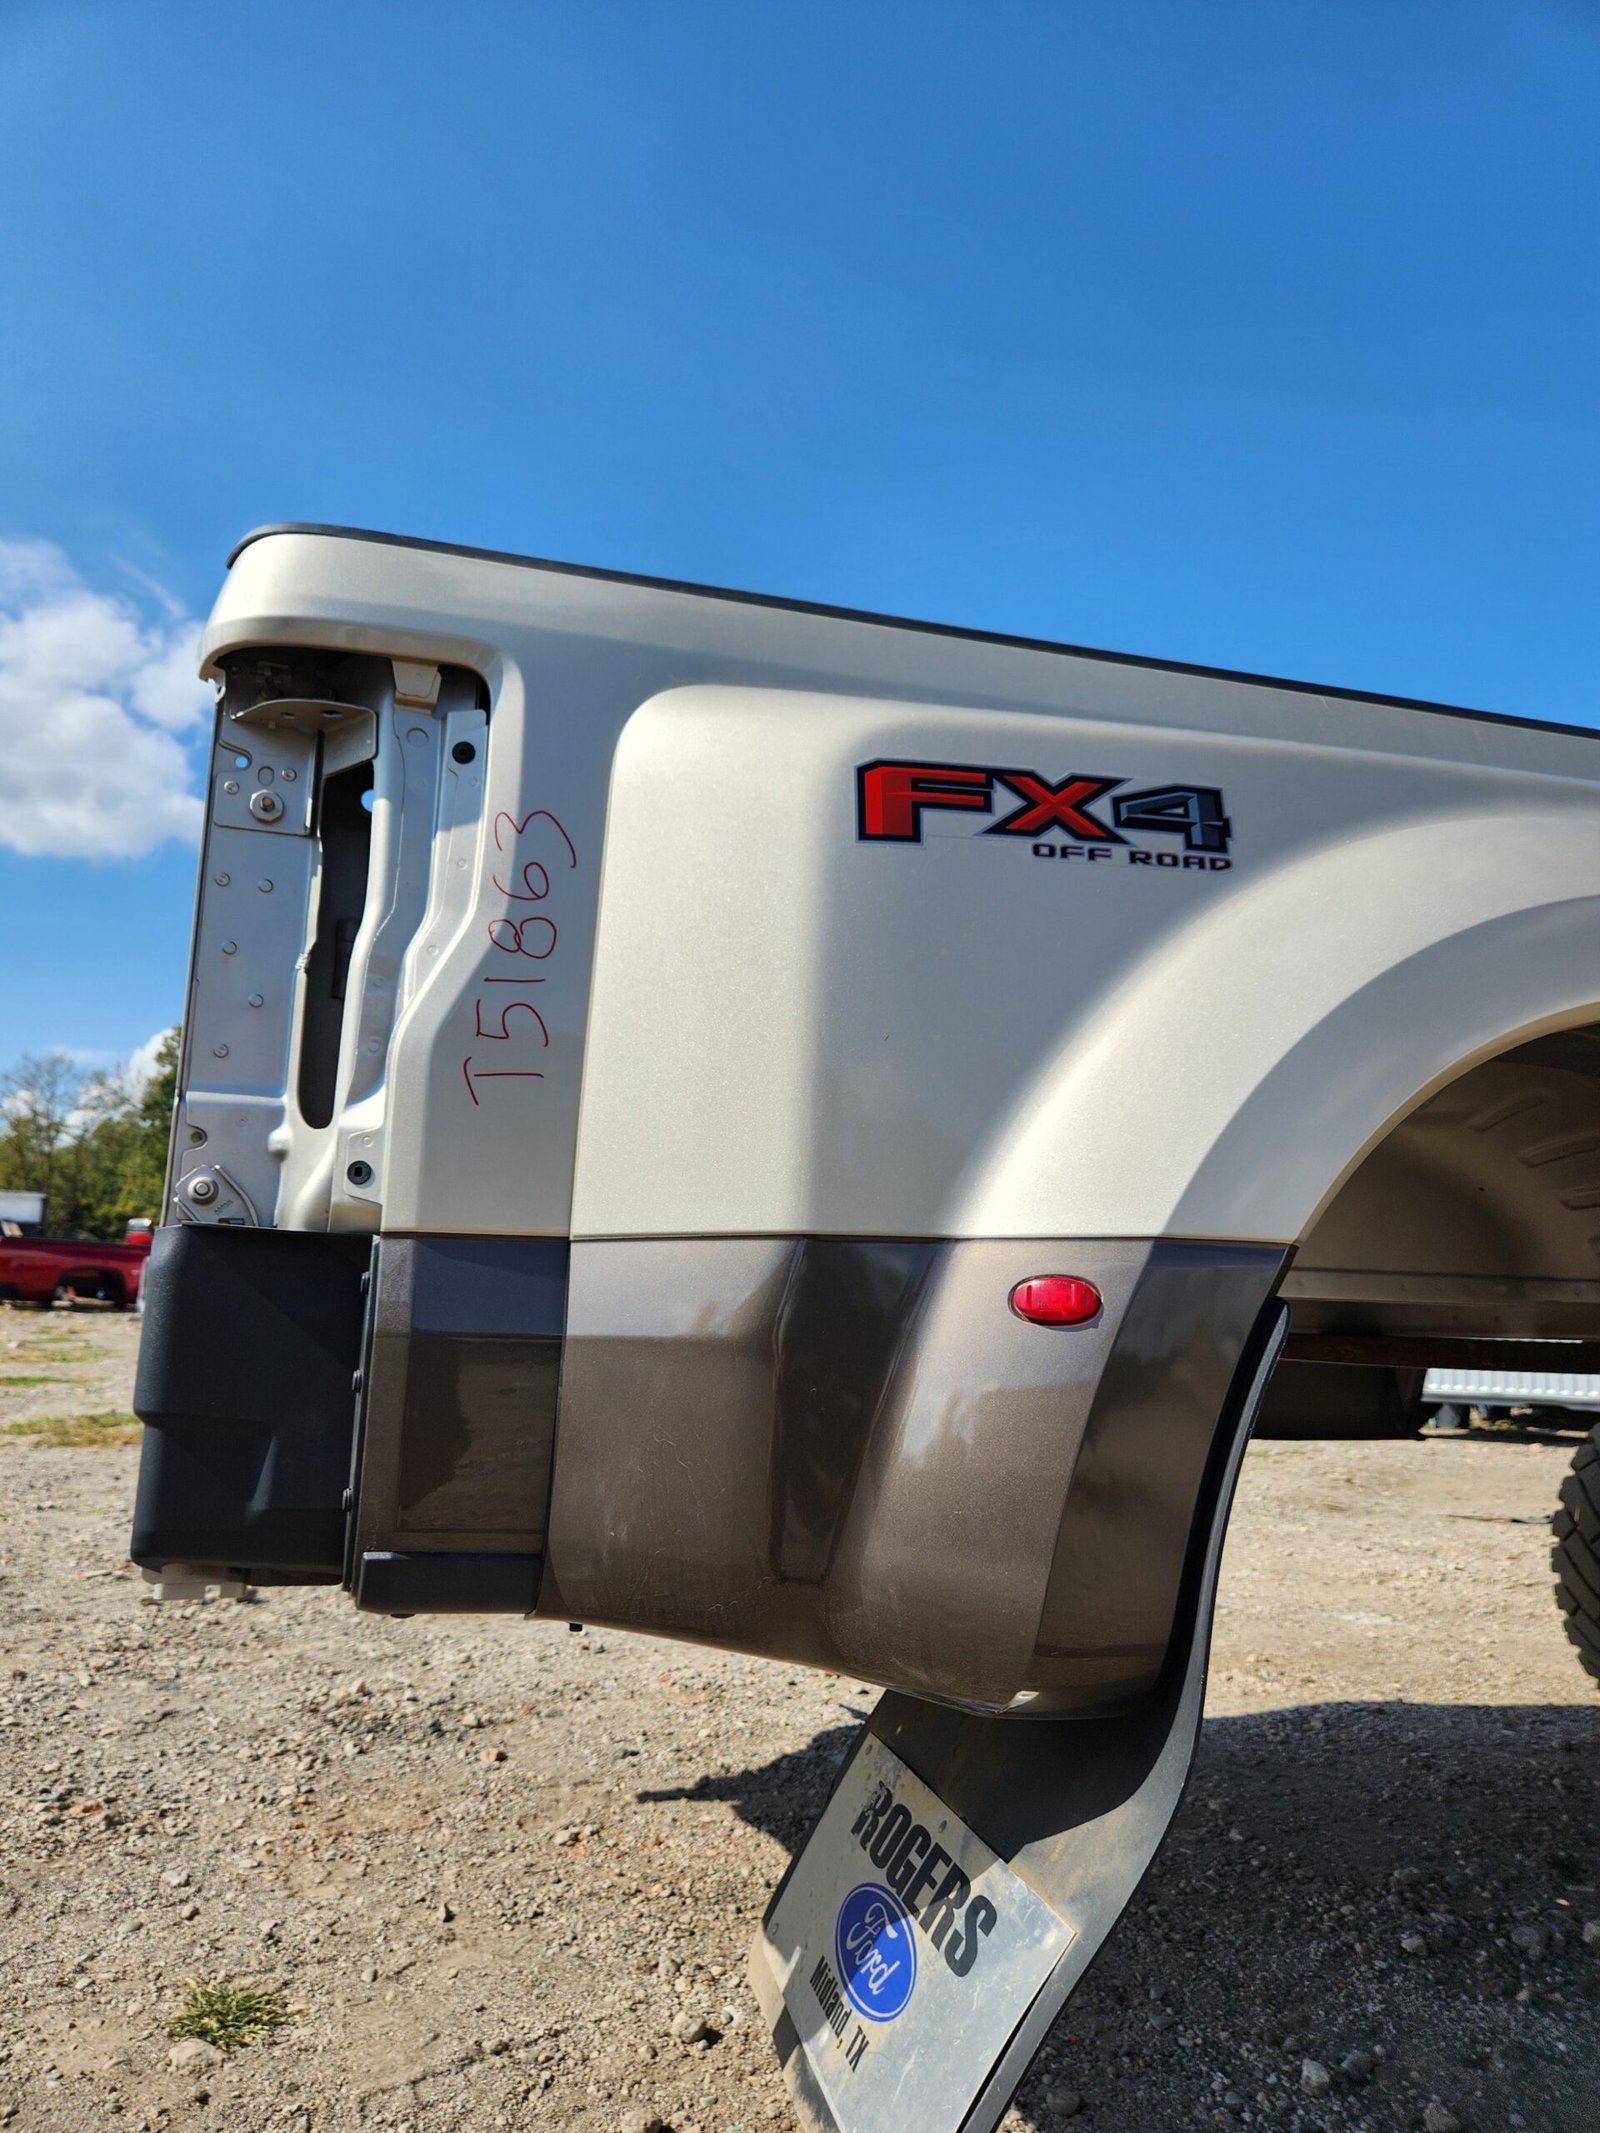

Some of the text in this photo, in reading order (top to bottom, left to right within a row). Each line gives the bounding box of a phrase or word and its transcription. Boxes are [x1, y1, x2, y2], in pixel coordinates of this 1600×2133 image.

[856, 757, 1232, 855] FX4
[1032, 843, 1233, 872] OFF ROAD
[463, 810, 577, 1106] T51863
[850, 1780, 998, 1978] ROGERS
[846, 1902, 899, 1996] Ford
[809, 1955, 871, 2073] Midland, TX
